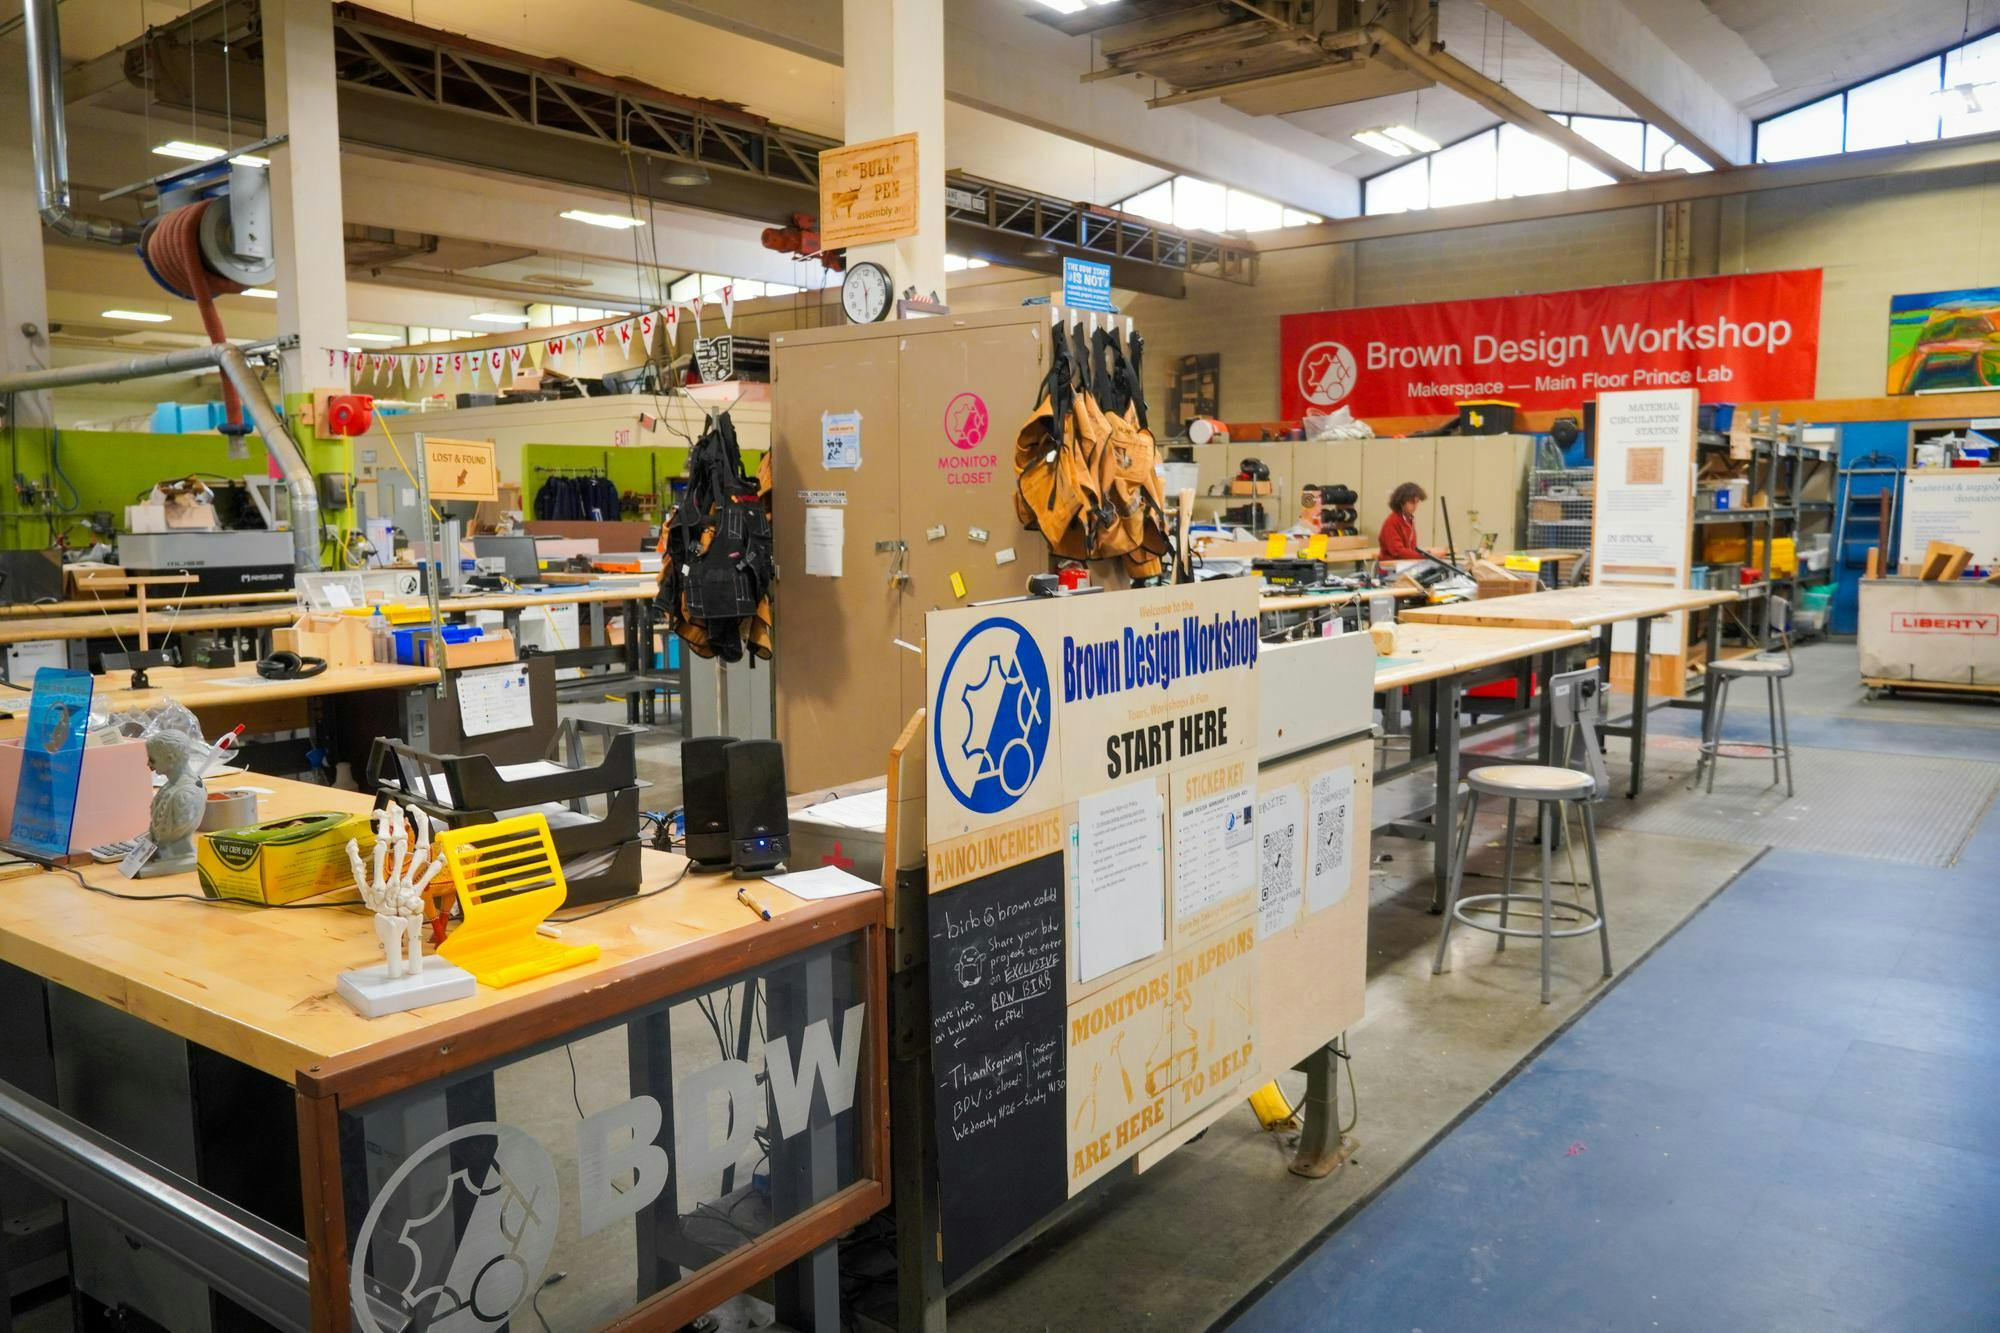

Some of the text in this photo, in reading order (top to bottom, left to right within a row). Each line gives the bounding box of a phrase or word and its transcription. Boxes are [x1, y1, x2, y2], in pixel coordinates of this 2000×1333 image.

[874, 181, 900, 201] PEN
[856, 206, 893, 220] assembly
[1072, 271, 1104, 287] IS NOT
[1367, 317, 1792, 370] Brown Design Workshop
[419, 349, 520, 374] DESIGN
[1408, 379, 1504, 398] Makerspace
[1535, 375, 1576, 392] Main
[1582, 372, 1628, 390] Floor
[1633, 368, 1691, 387] Prince
[1696, 365, 1733, 384] Lab
[1609, 414, 1680, 426] CIRCULATION
[1628, 401, 1680, 413] MATERIAL
[615, 430, 630, 447] EXIT
[1635, 426, 1679, 437] STATION
[432, 452, 487, 465] LOST & FOUND
[938, 455, 997, 470] MONITOR
[947, 472, 992, 485] CLOSET
[1955, 482, 1964, 492] &
[1607, 534, 1654, 544] IN STOCK
[1140, 600, 1195, 618] Welcome to the
[1902, 617, 1988, 629] LIBERTY
[1064, 610, 1258, 703] Brown Design Workshop
[1106, 706, 1228, 780] START HERE
[1185, 761, 1245, 801] STICKER KEY
[935, 816, 1060, 884] ANNOUNCEMENTS
[988, 916, 1060, 951] Share your bdw
[990, 939, 1062, 975] projects to enter
[1005, 953, 1060, 983] EXCLUSIVE
[991, 970, 1052, 1011] BDW BIRB
[1071, 928, 1254, 1047] MONITORS IN APRONS
[934, 1001, 975, 1027] more info
[994, 1004, 1024, 1030] raffle!
[935, 1014, 982, 1044] on bulletin
[949, 1050, 1022, 1089] Thanksgiving
[952, 1112, 996, 1141] Wednesday
[1024, 1088, 1046, 1105] Sunday
[953, 1089, 981, 1121] BDW
[985, 1088, 993, 1100] is
[1072, 1042, 1253, 1179] ARE HERE TO HELP
[576, 1002, 866, 1239] BDW
